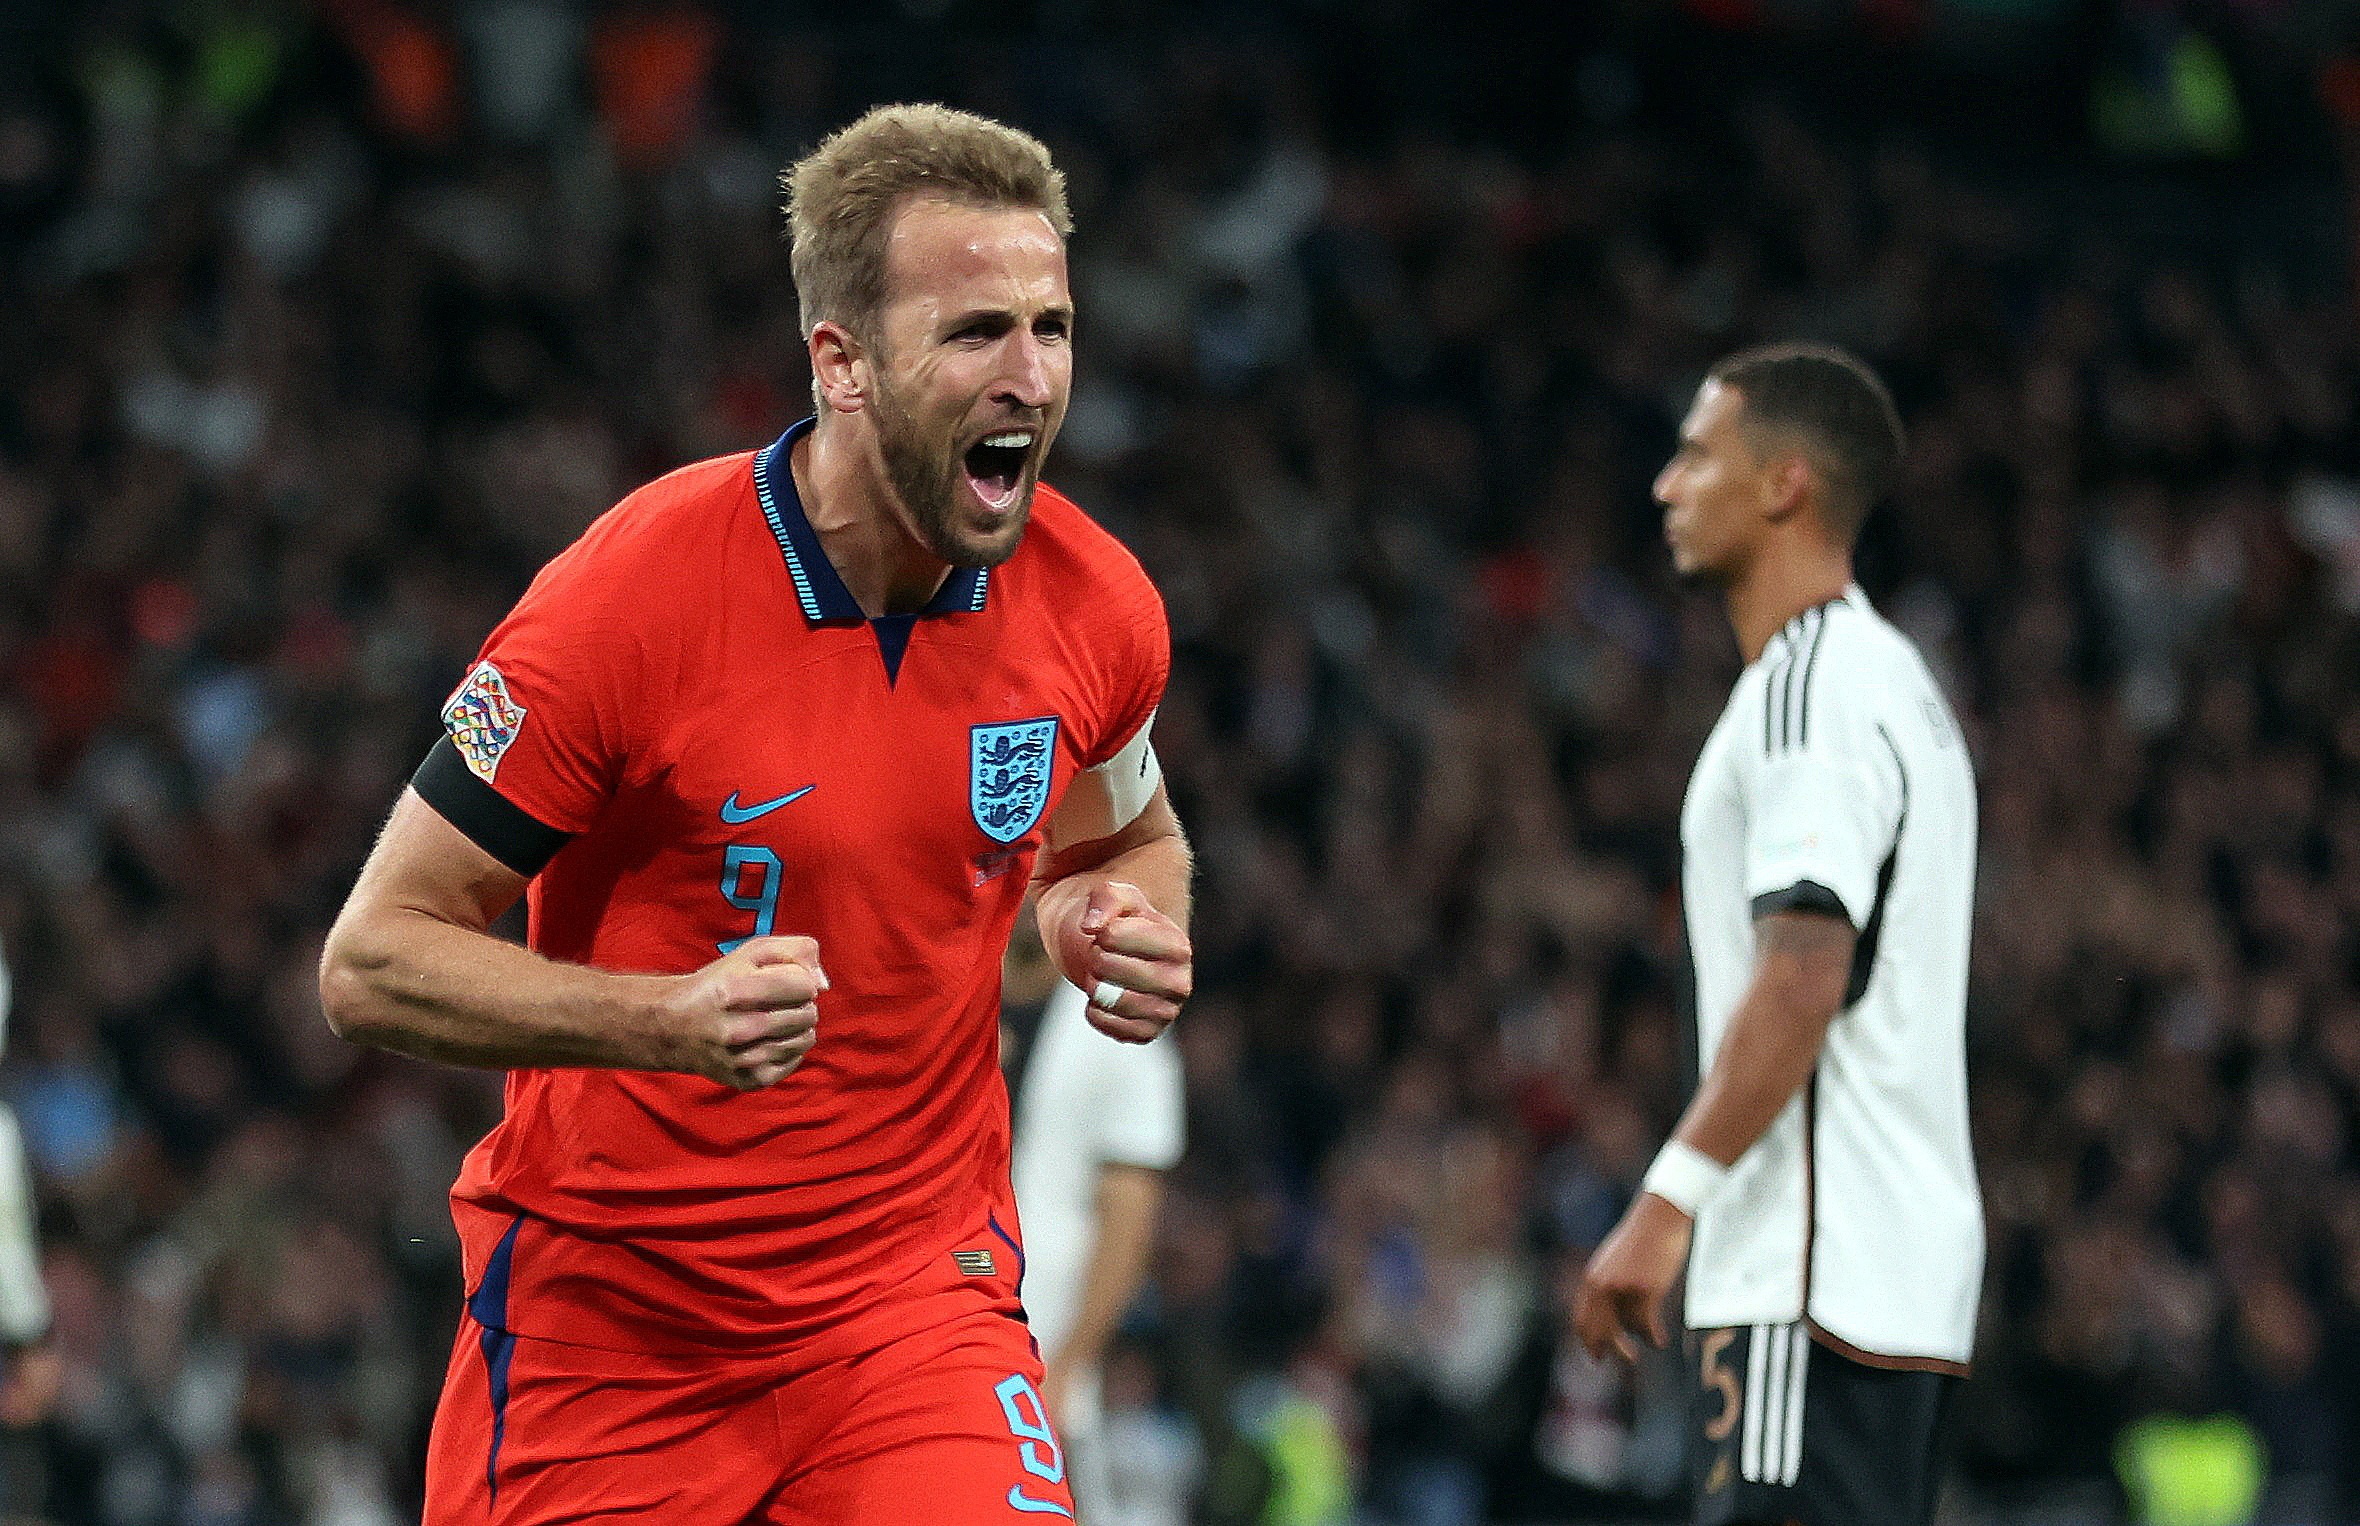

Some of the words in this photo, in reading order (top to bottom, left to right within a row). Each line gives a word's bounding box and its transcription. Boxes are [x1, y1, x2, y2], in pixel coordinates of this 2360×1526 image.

[716, 844, 784, 956] 9
[993, 1373, 1064, 1484] 9
[1701, 1329, 1742, 1440] 5
